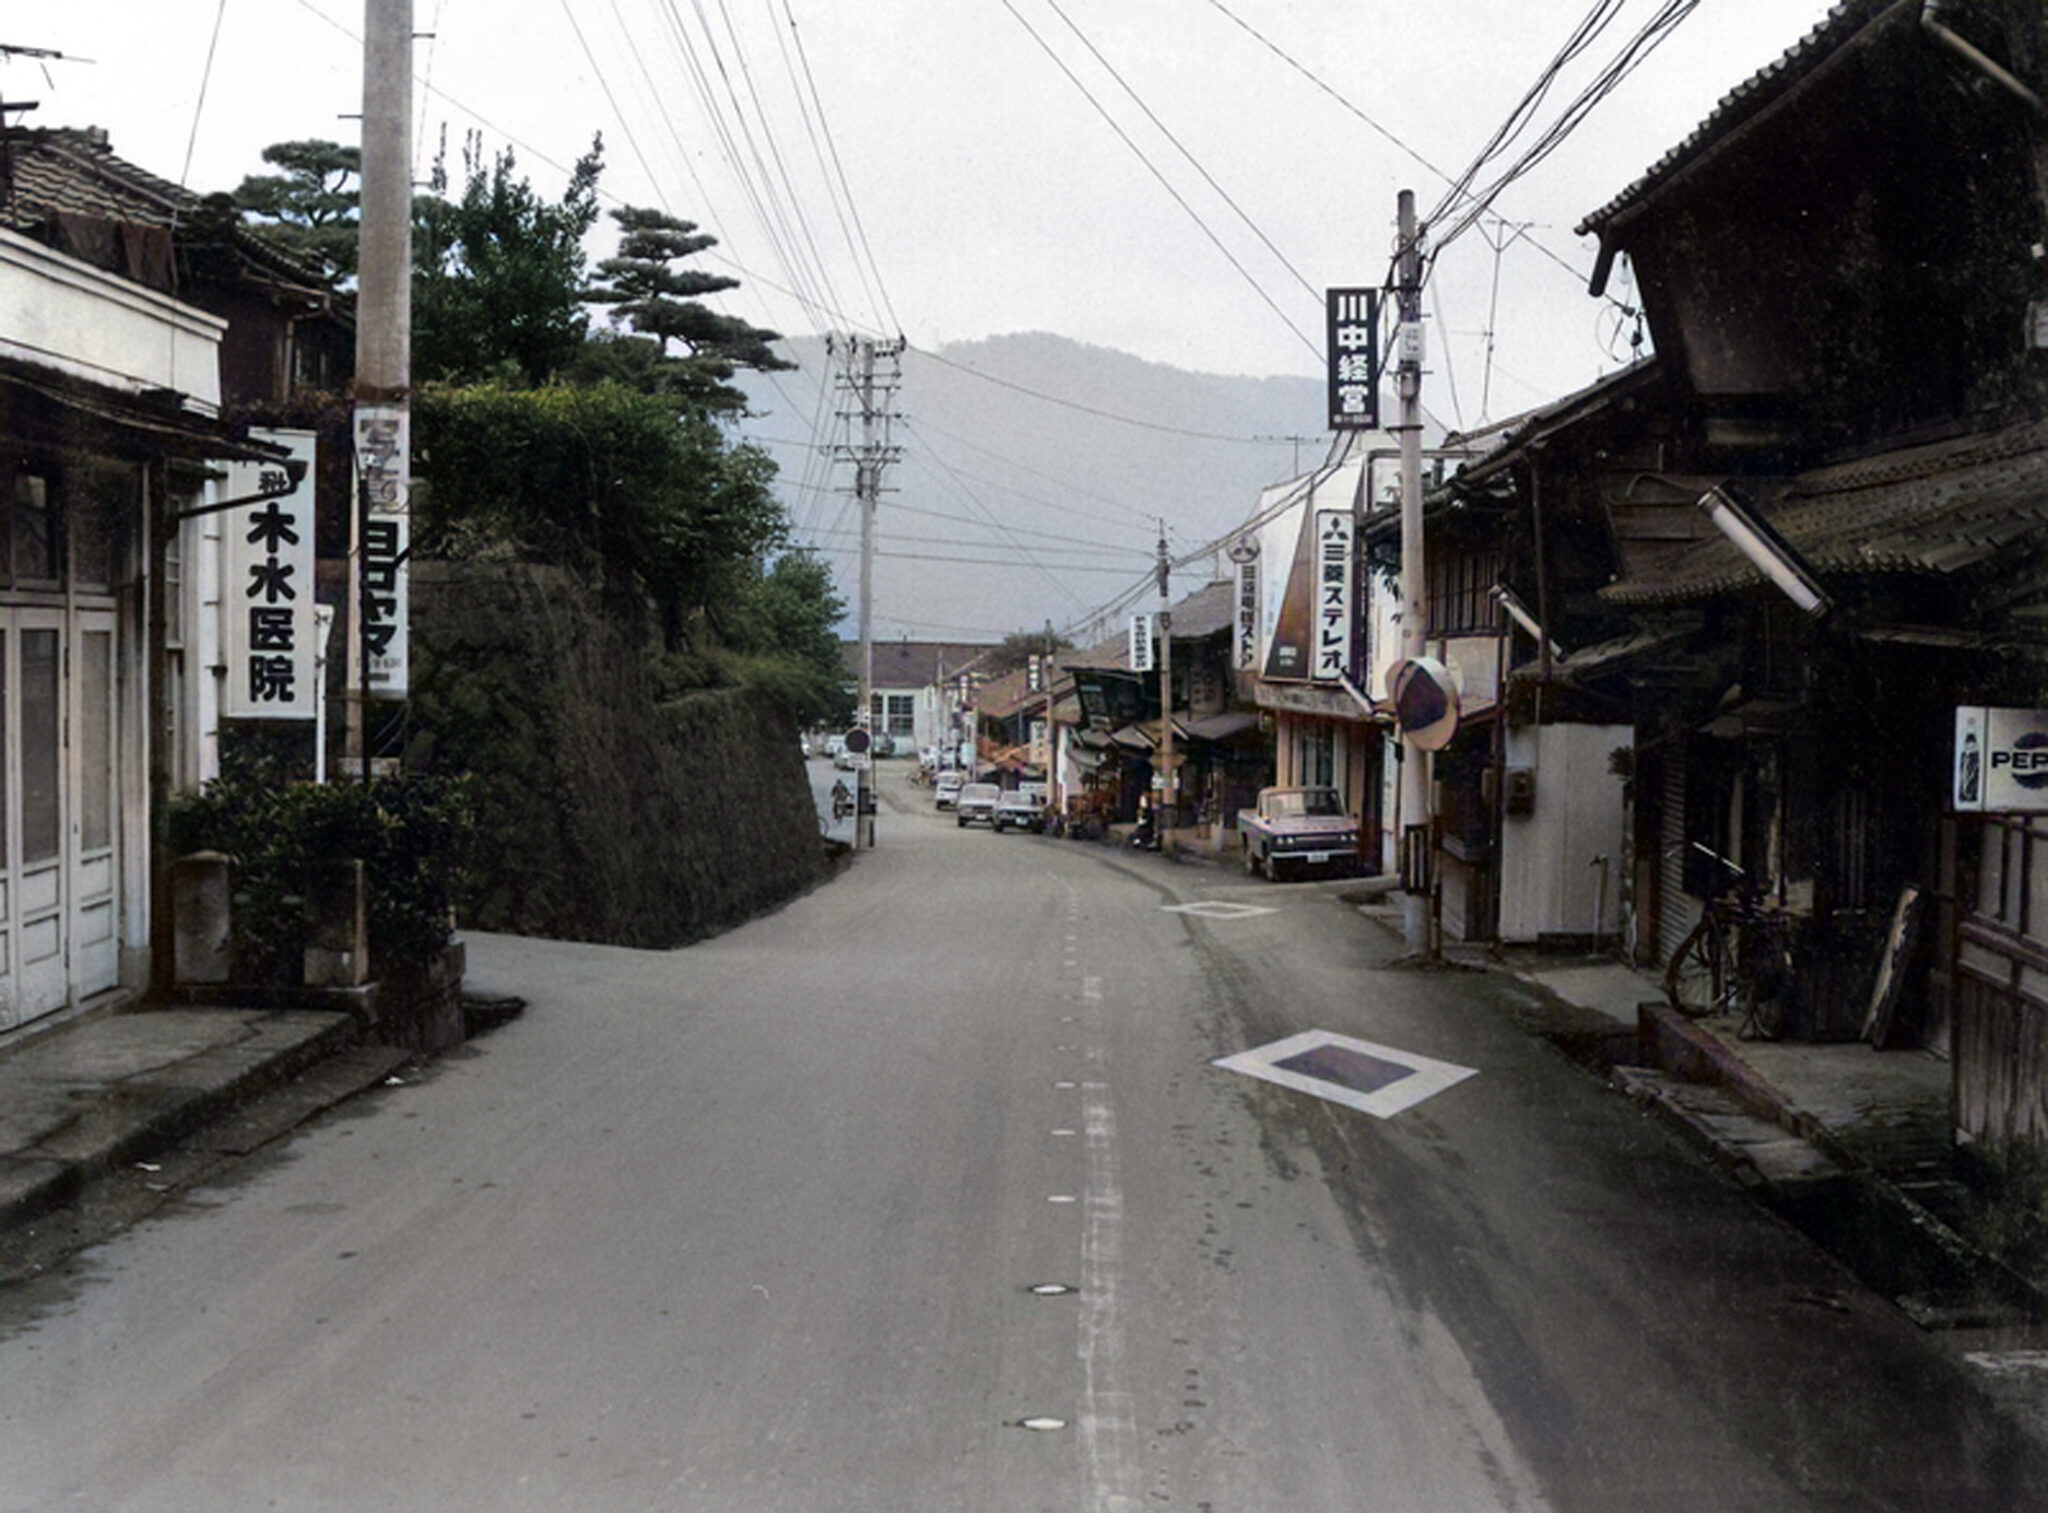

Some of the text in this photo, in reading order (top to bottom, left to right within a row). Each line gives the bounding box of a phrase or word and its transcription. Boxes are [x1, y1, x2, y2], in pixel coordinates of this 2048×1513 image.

[1337, 294, 1368, 413] 川中経営
[246, 502, 299, 702] 木水医院
[1321, 543, 1347, 670] 三菱ステレオ
